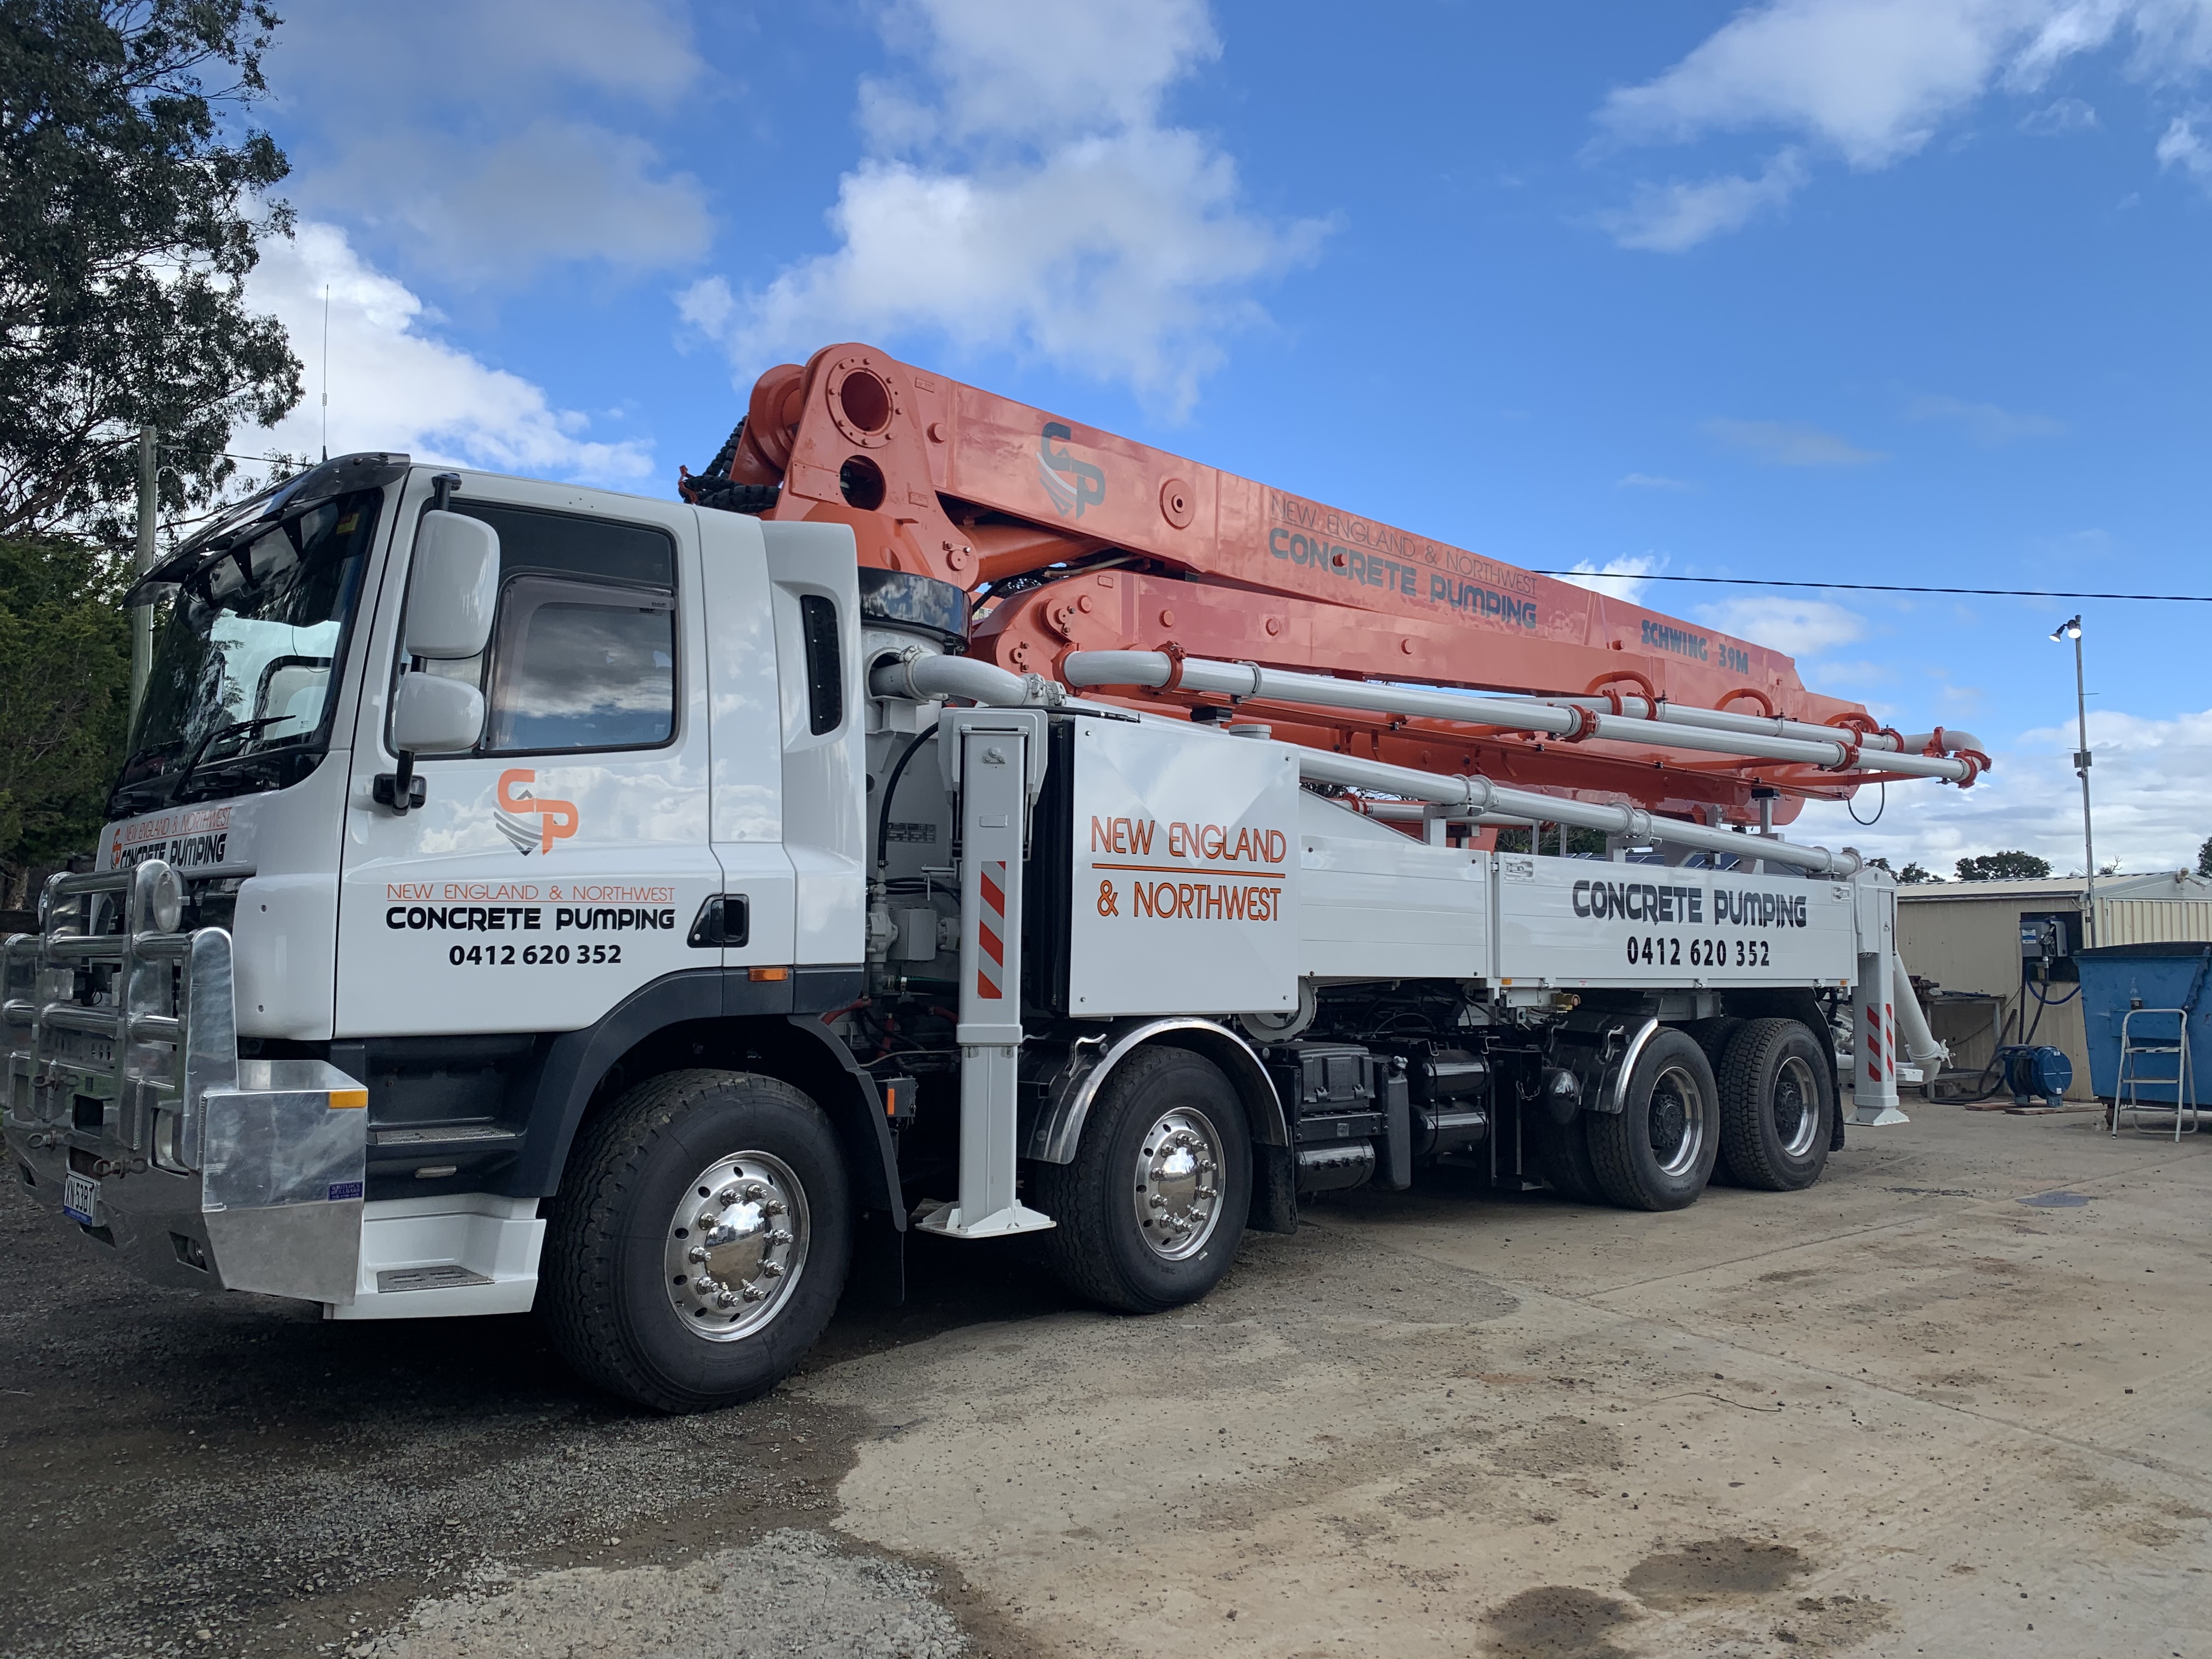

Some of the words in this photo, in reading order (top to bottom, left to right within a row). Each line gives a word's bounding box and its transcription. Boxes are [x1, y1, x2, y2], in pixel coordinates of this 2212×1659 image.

[1271, 495, 1317, 527] NEW
[1327, 514, 1416, 557] ENGLAND
[1425, 545, 1438, 566] &
[1447, 551, 1537, 595] NORTHWEST
[1269, 527, 1417, 597] CONCRETE
[1430, 573, 1537, 629] PUMPING
[1641, 619, 1708, 662] SCHWING
[1718, 644, 1748, 675] 39M
[124, 825, 137, 842] NEW
[138, 817, 170, 839] ENGLAND
[172, 816, 178, 834] &
[181, 807, 233, 832] NORTHWEST
[1092, 816, 1155, 854] NEW
[1169, 822, 1286, 863] ENGLAND
[170, 833, 227, 867] PUMPING
[387, 884, 434, 899] NEW
[444, 884, 539, 900] ENGLAND
[549, 885, 562, 900] &
[573, 886, 675, 901] NORTHWEST
[1097, 880, 1118, 917] &
[1134, 882, 1281, 921] NORTHWEST
[1572, 880, 1702, 926] CONCRETE
[1714, 889, 1807, 928] PUMPING
[386, 907, 541, 932] CONCRETE
[556, 907, 675, 931] PUMPING
[449, 945, 515, 966] 0412
[523, 945, 569, 965] 620
[577, 945, 621, 964] 352
[1627, 936, 1680, 965] 0412
[1690, 939, 1726, 966] 620
[1736, 940, 1769, 966] 352
